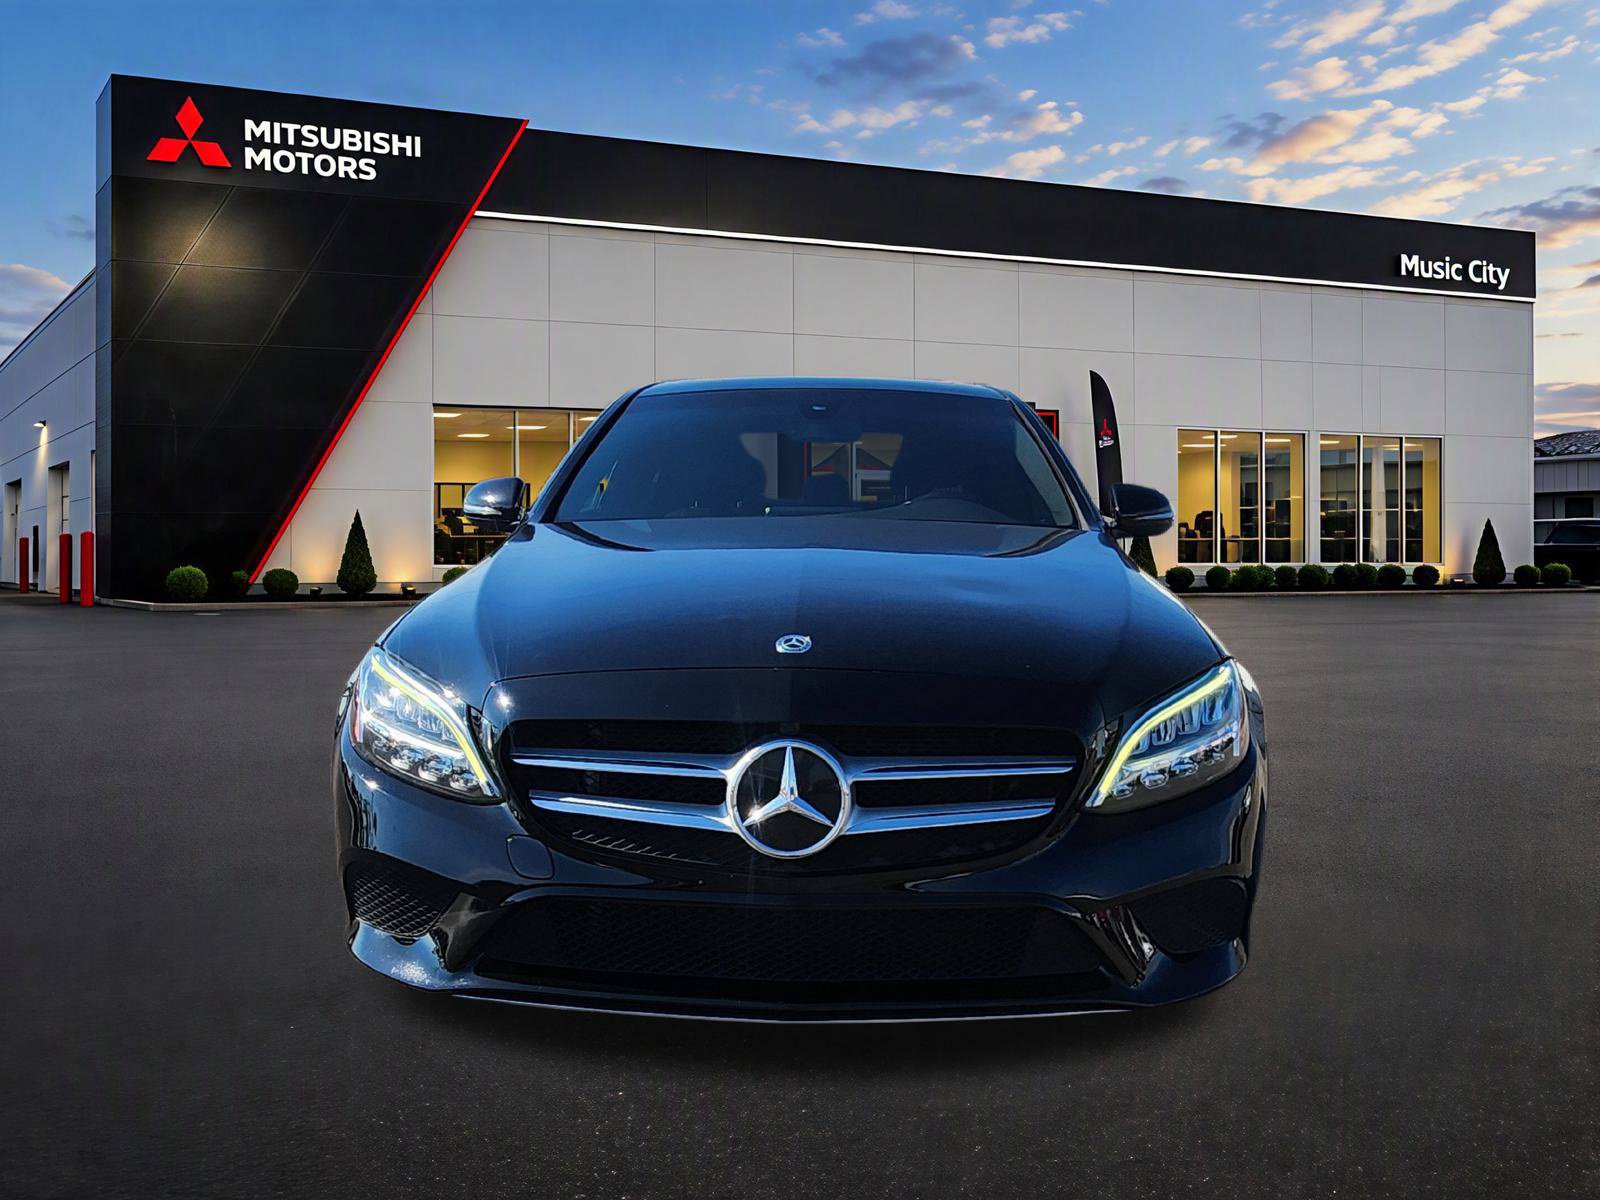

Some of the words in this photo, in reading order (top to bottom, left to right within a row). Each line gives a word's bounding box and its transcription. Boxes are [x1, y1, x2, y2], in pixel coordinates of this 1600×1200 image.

[244, 118, 421, 158] MITSUBISHI
[244, 146, 377, 181] MOTORS
[1400, 253, 1463, 281] Music
[1468, 259, 1511, 290] City
